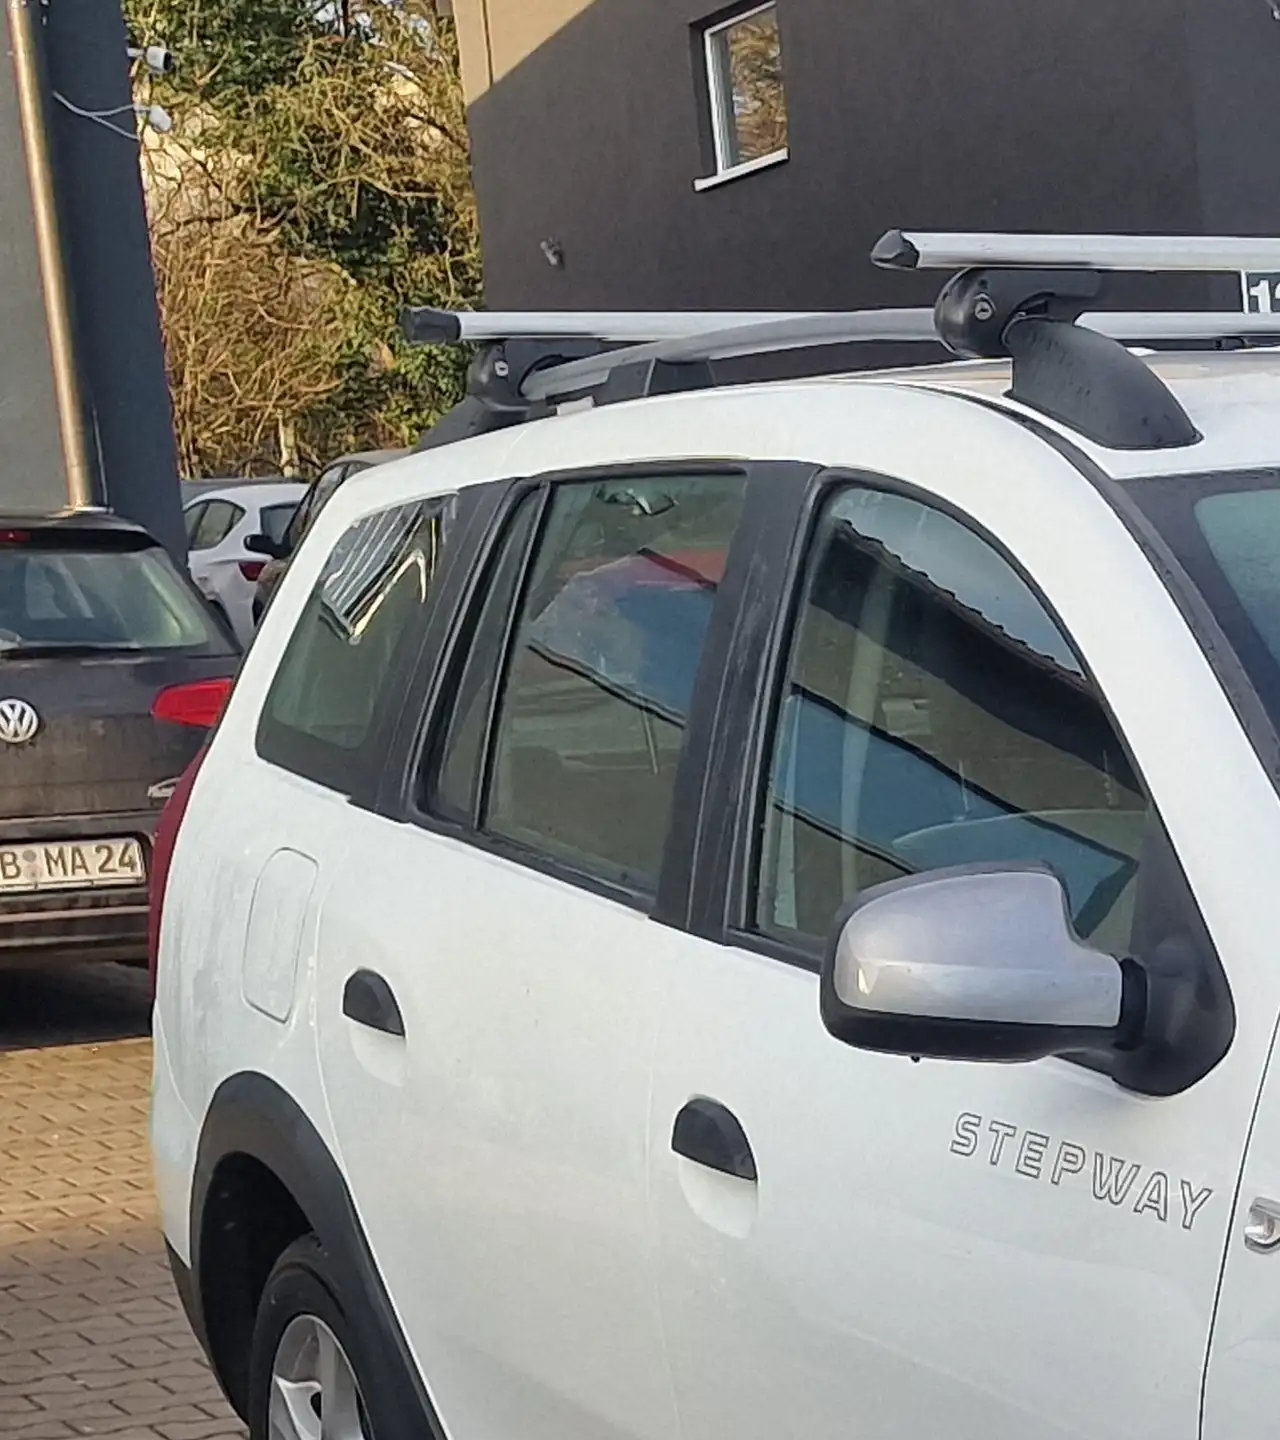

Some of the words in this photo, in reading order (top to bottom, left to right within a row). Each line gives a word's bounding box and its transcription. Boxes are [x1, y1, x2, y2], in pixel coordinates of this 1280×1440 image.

[44, 844, 89, 877] MA
[94, 841, 137, 874] 24
[949, 1112, 1213, 1230] STEPWAY
